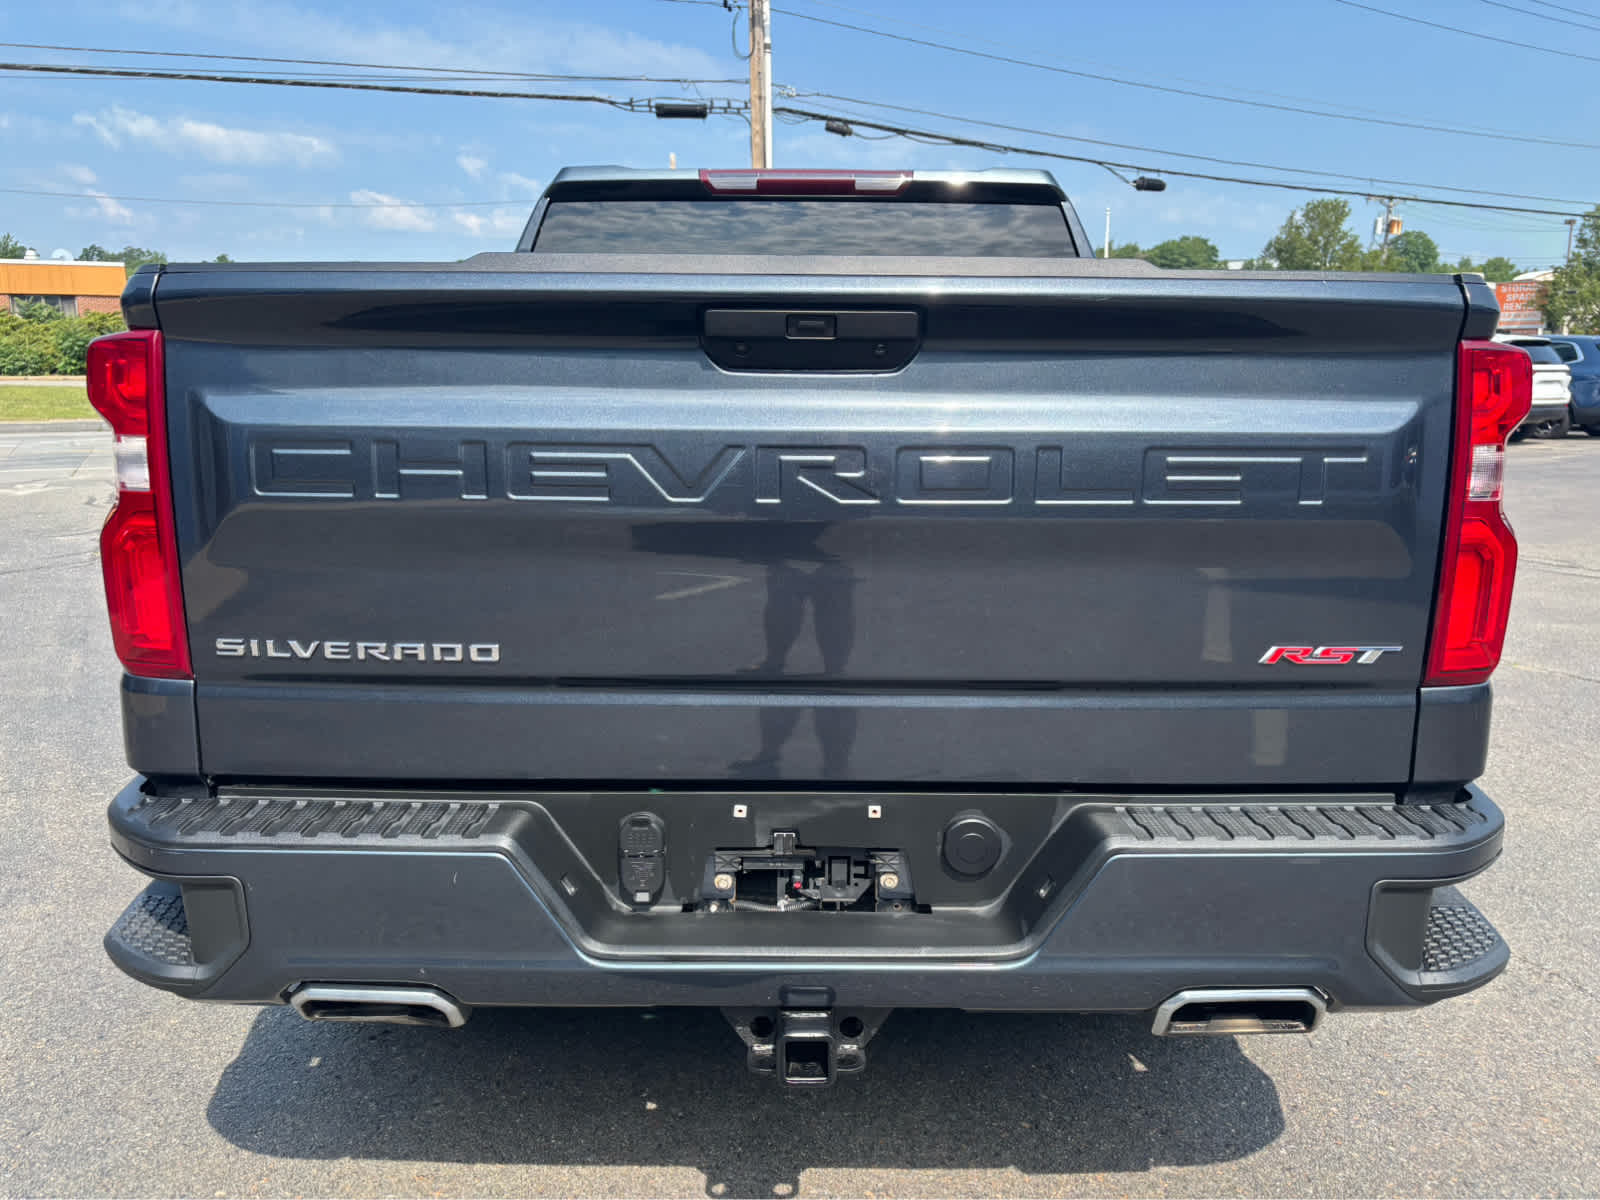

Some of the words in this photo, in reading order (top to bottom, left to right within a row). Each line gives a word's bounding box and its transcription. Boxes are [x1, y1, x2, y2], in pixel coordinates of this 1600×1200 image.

[249, 440, 1367, 504] CHEVROLET
[215, 637, 500, 662] SILVERADO
[1258, 645, 1403, 664] RST
